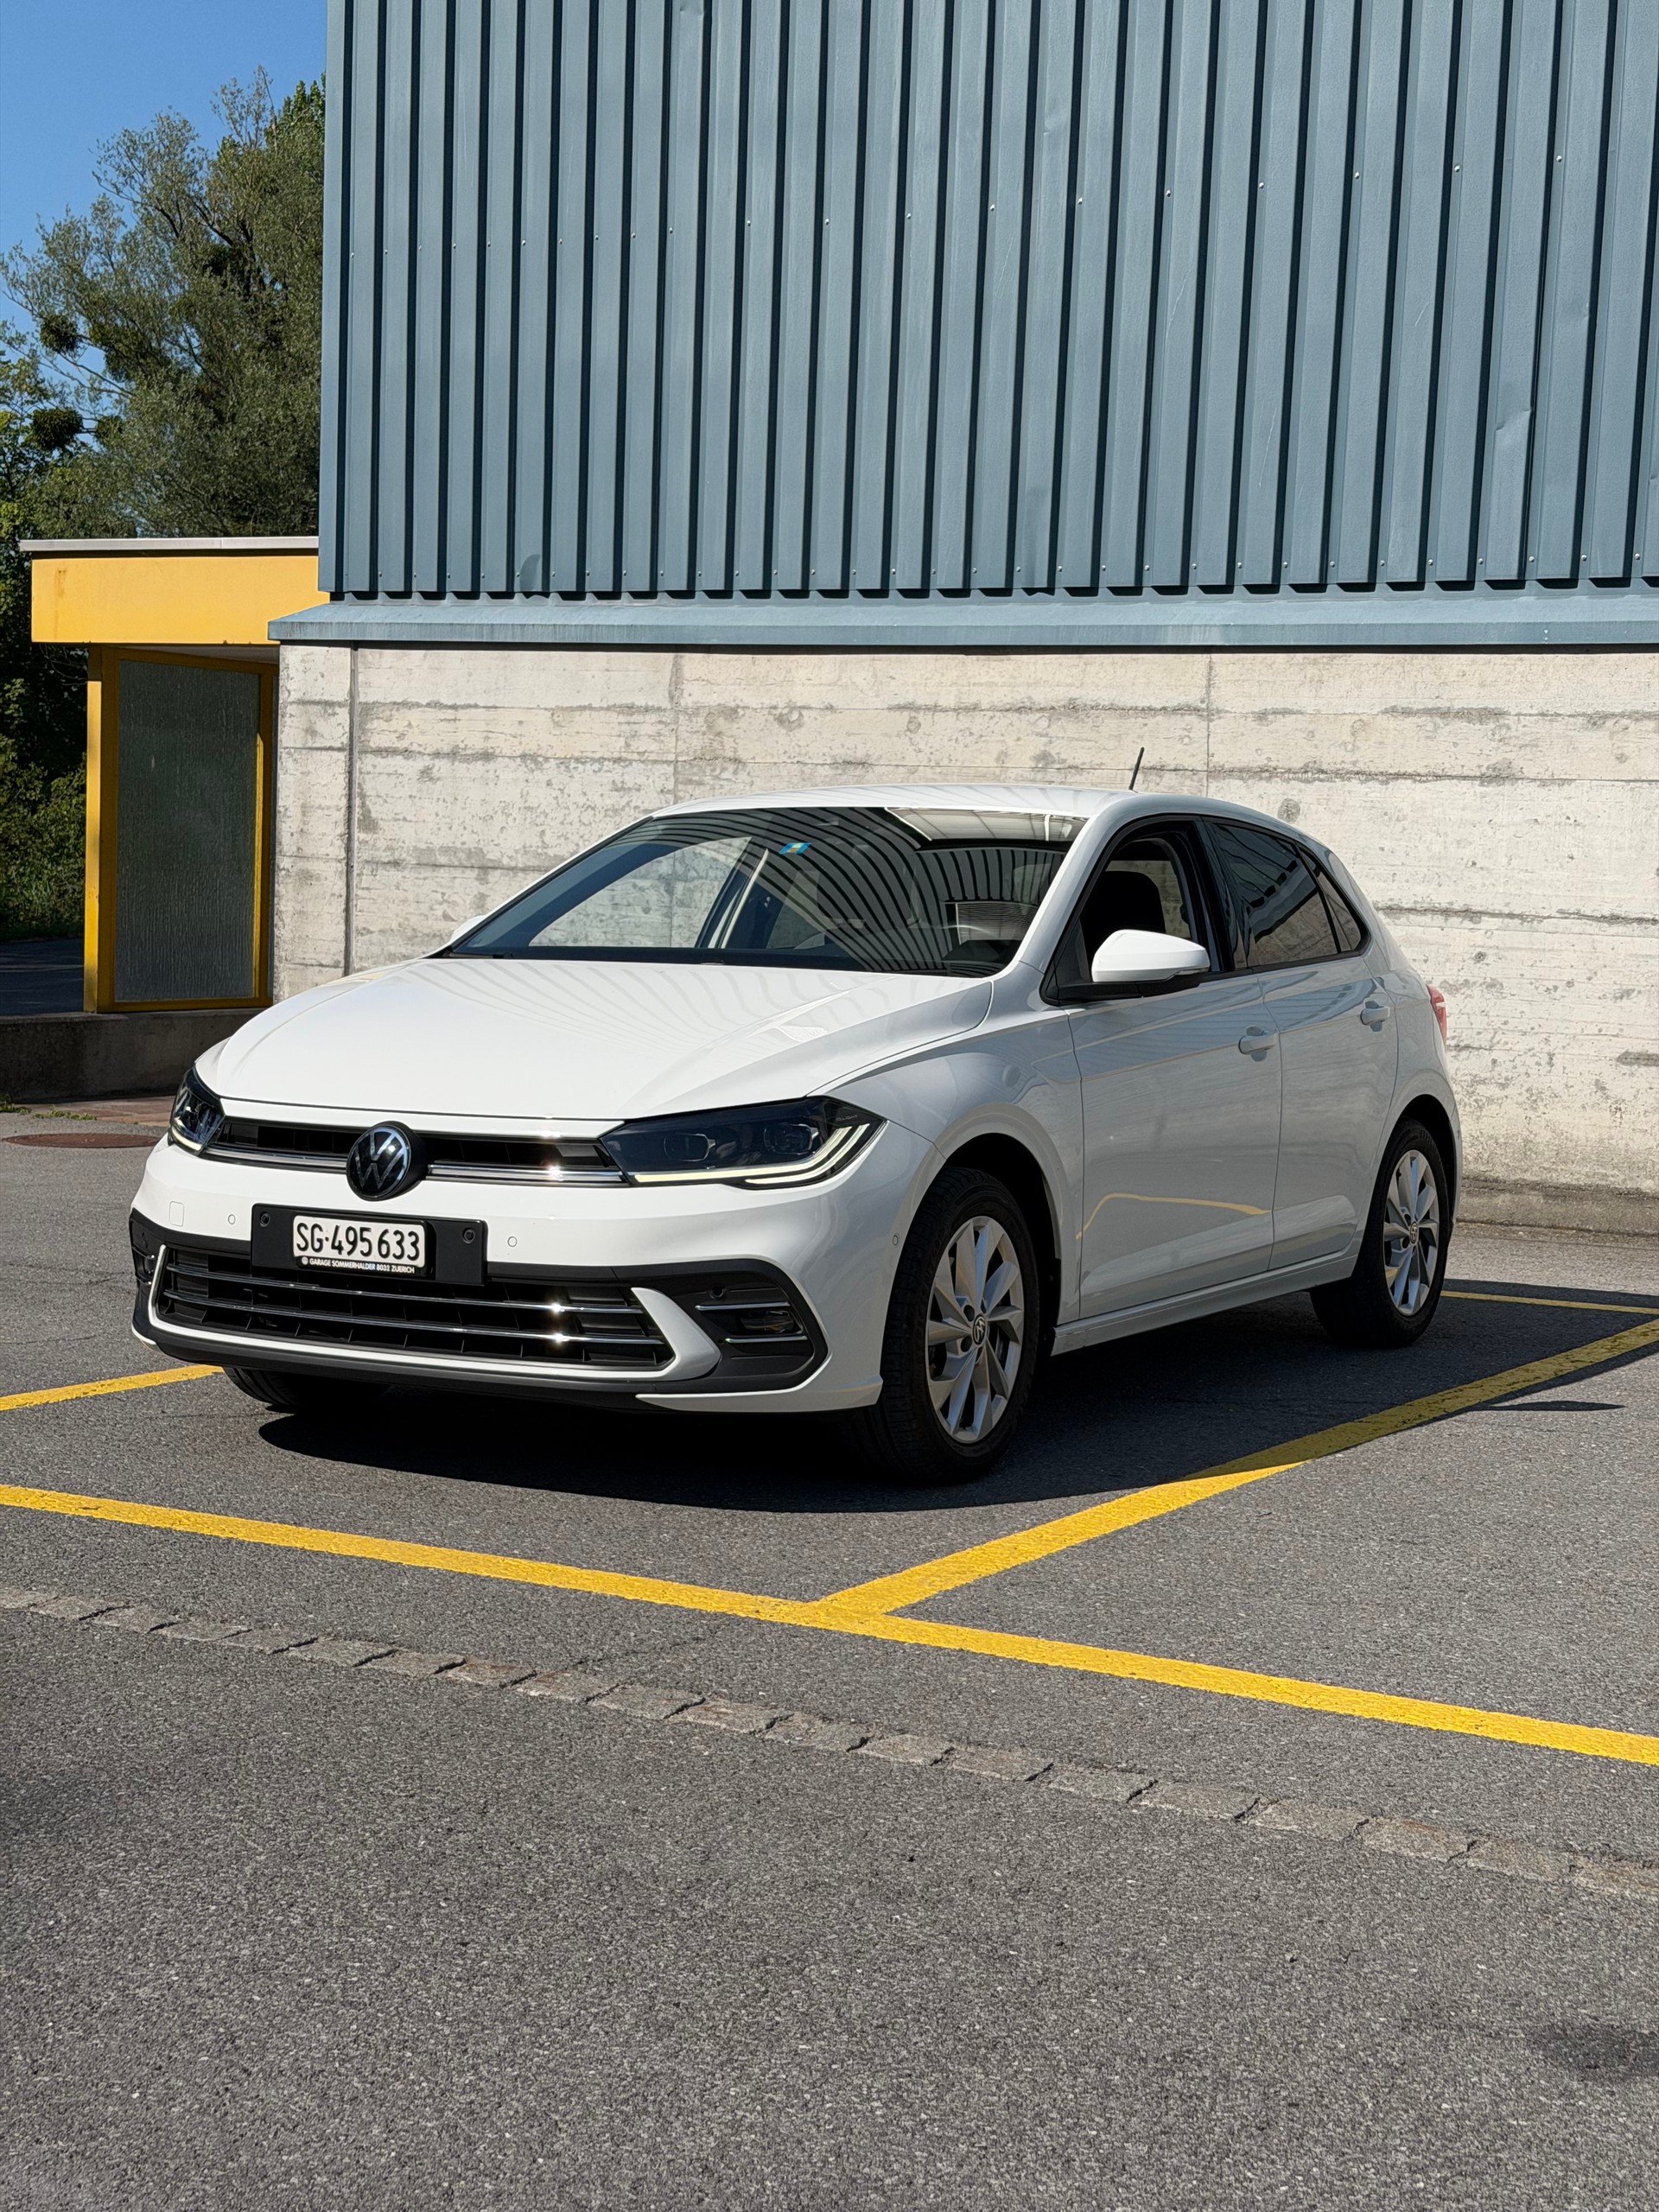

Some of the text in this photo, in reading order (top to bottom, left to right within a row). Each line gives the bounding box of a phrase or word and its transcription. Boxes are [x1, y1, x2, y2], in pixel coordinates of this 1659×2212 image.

[309, 1257, 331, 1267] GARAGE
[332, 1260, 376, 1270] SOMMERHALDER
[376, 1263, 391, 1272] 8032
[391, 1265, 415, 1274] ZUERICH
